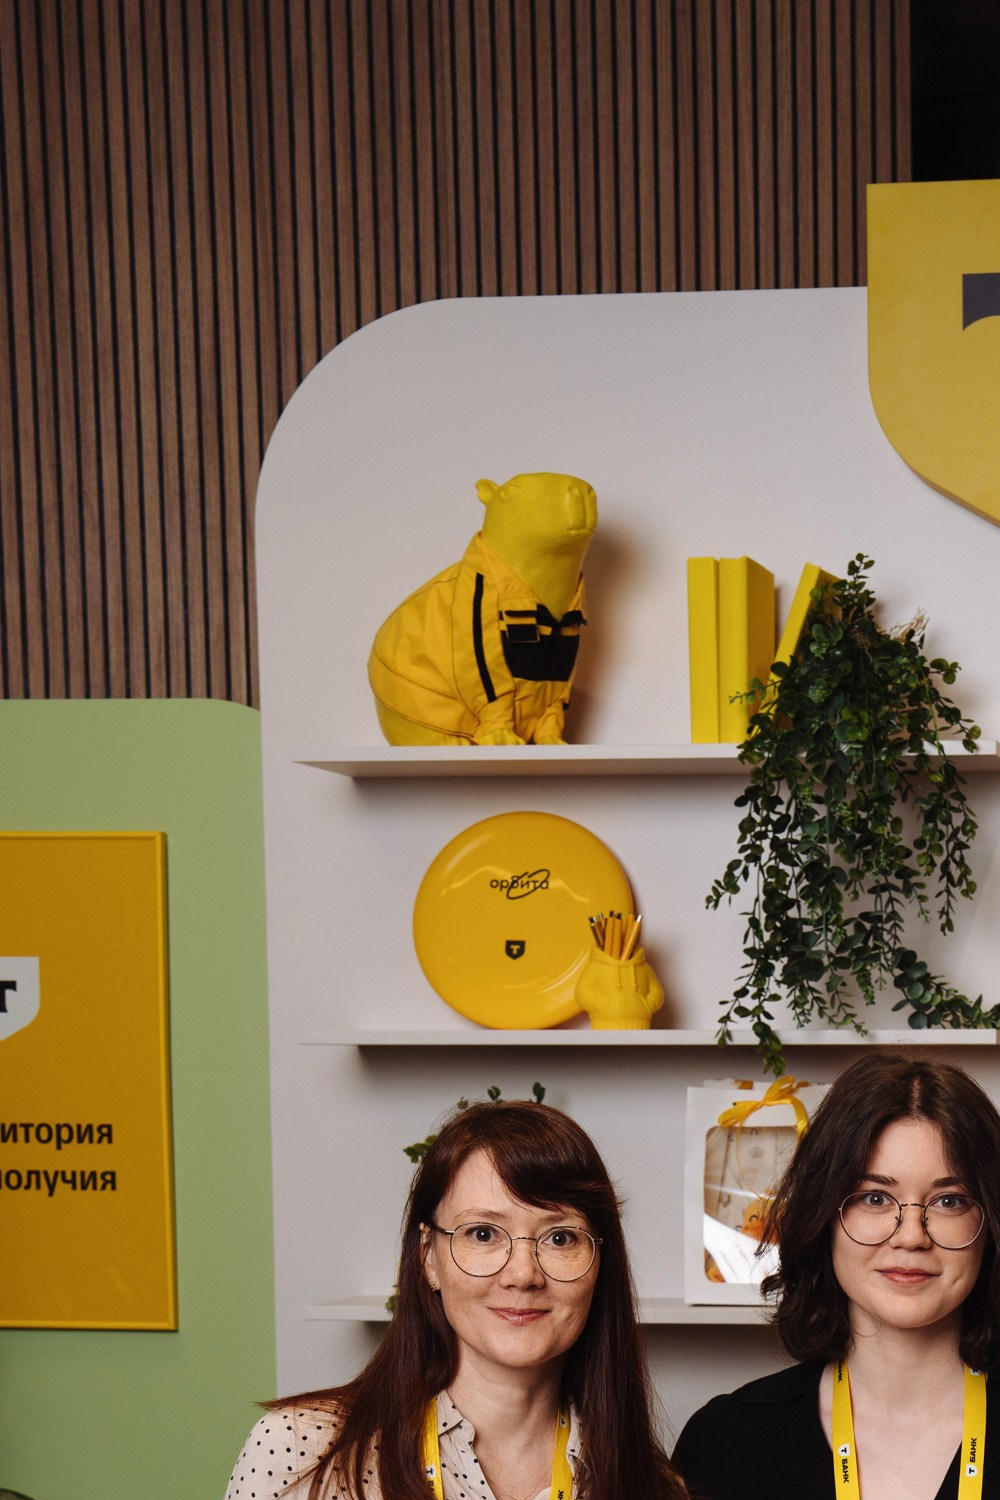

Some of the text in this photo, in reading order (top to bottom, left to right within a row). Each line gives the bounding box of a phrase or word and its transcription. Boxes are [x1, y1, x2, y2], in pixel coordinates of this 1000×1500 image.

[489, 874, 549, 892] орбита
[0, 1169, 117, 1198] олучия
[969, 1437, 977, 1463] БАНК
[841, 1458, 850, 1484] БАНК
